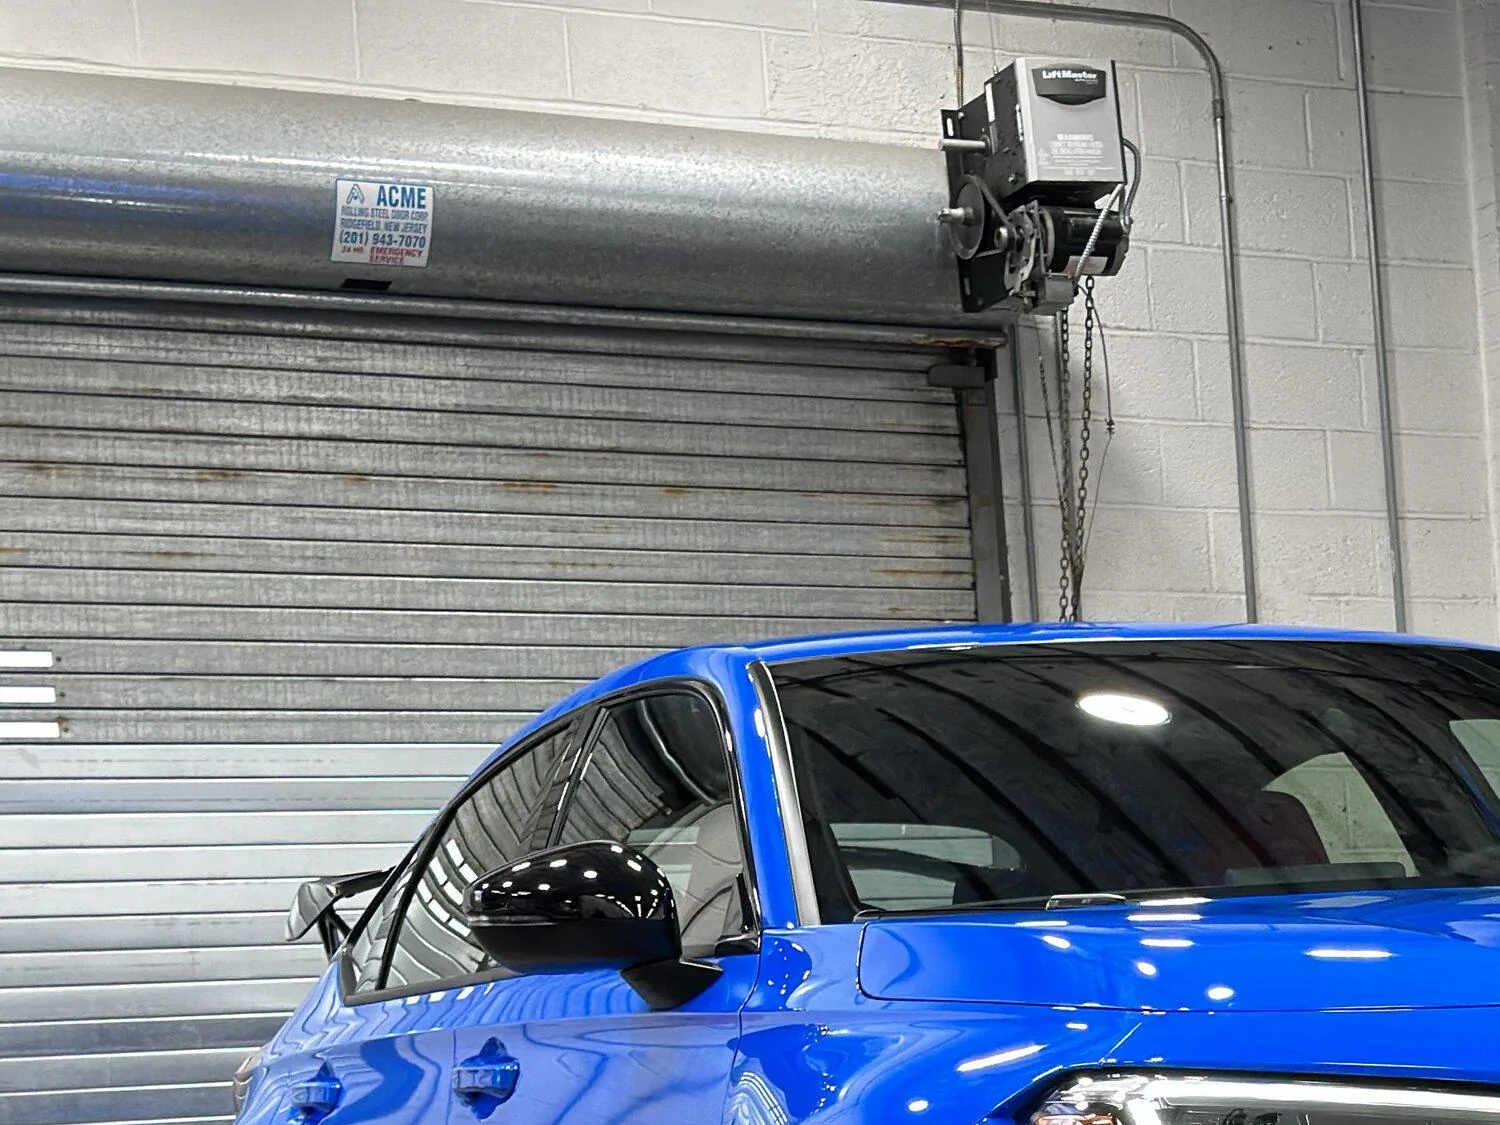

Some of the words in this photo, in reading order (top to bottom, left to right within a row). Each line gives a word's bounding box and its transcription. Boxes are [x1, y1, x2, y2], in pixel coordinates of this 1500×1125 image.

[1042, 70, 1097, 79] LiftMaster
[377, 185, 426, 209] ACME
[371, 208, 389, 219] STEEL
[384, 222, 400, 232] NEW
[402, 223, 428, 234] JERSEY
[340, 229, 369, 246] (201)
[372, 233, 426, 248] 943-7070
[371, 245, 423, 257] EMERGENCY
[369, 255, 404, 265] SERVICE
